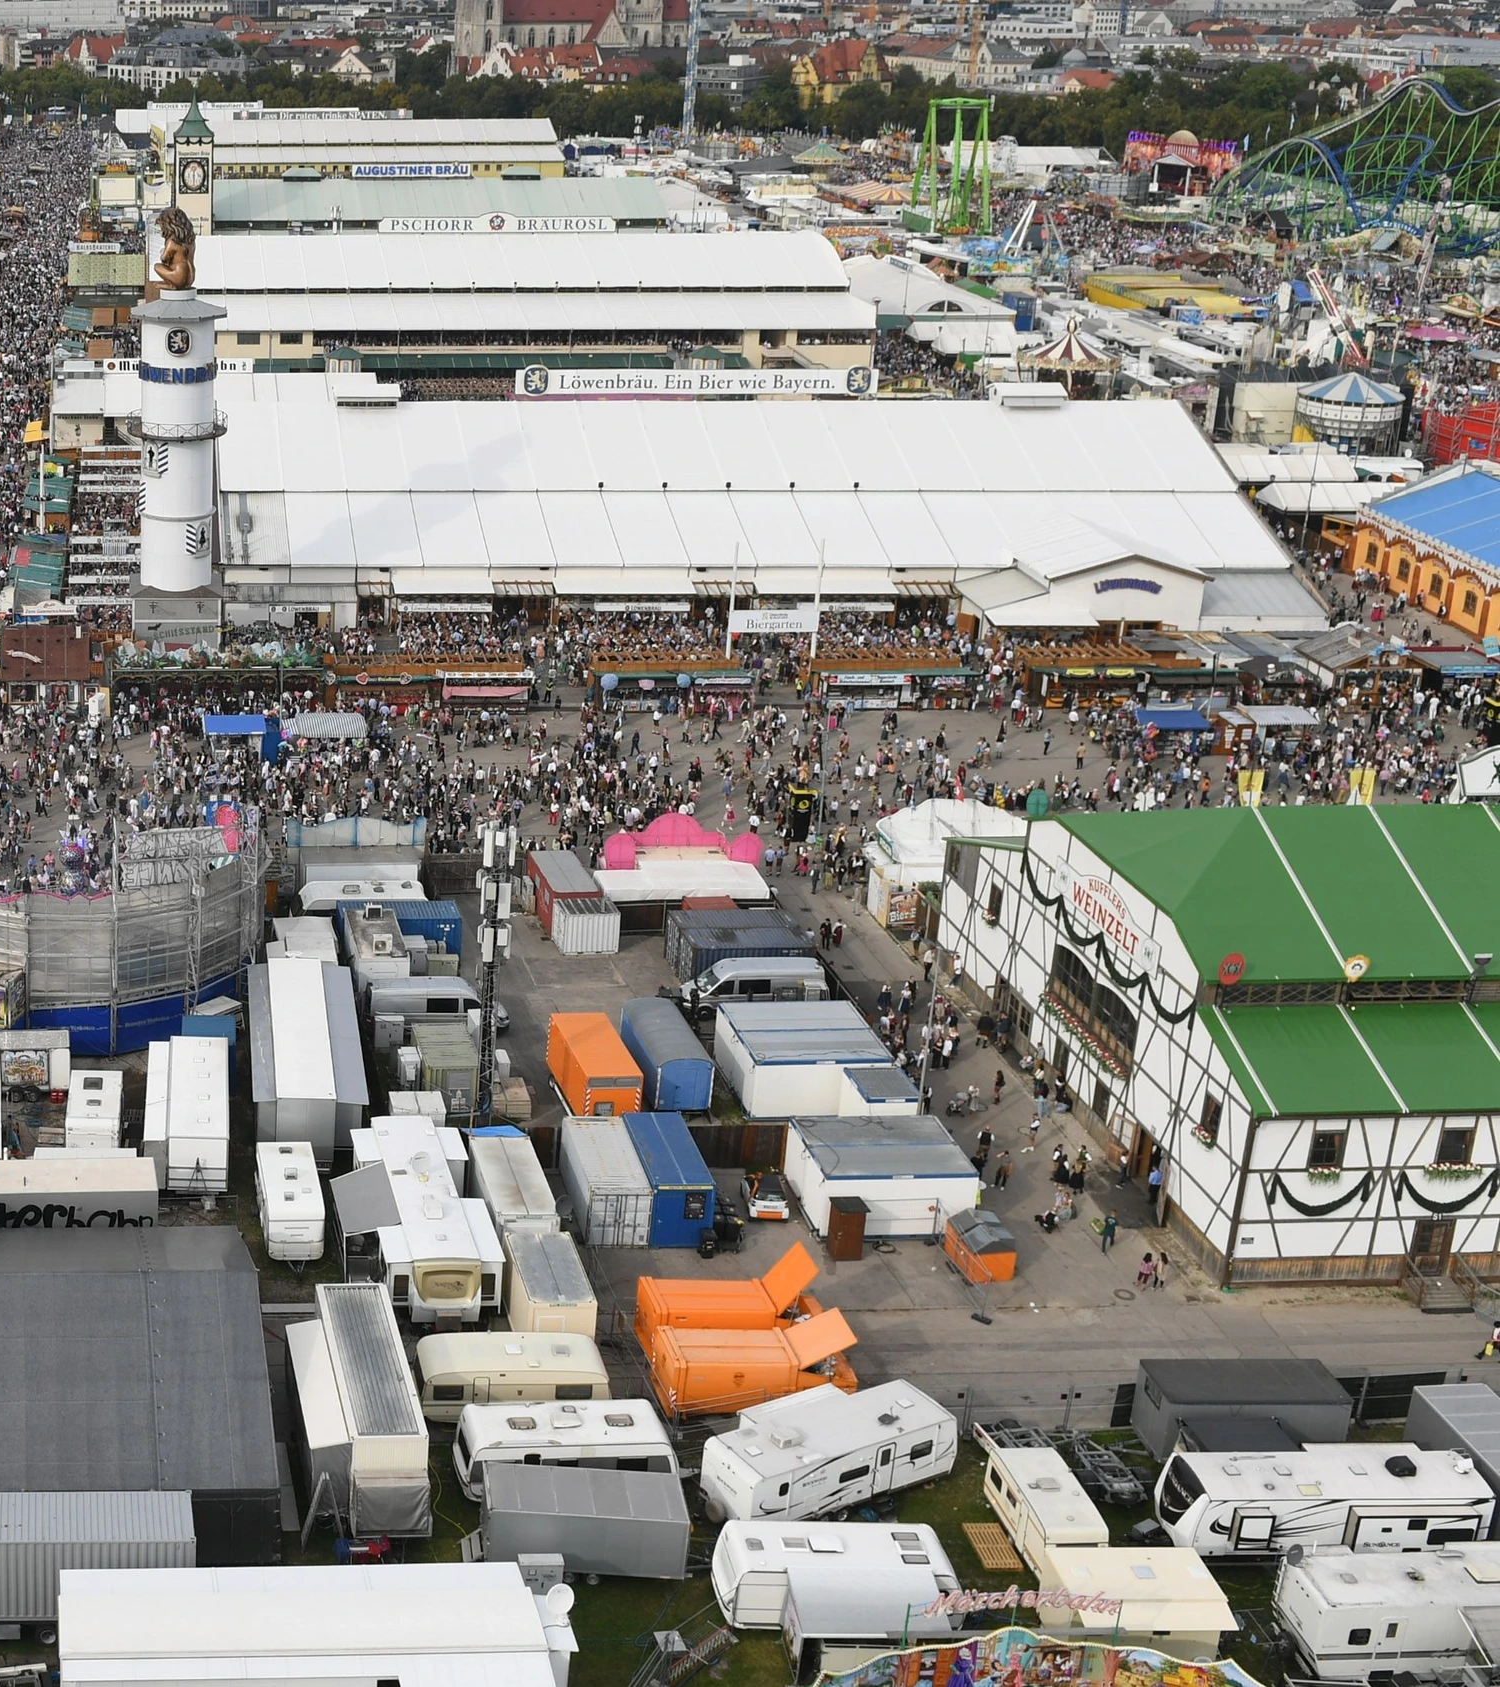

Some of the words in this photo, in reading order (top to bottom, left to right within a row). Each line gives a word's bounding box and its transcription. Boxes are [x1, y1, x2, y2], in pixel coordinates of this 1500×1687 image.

[280, 112, 294, 120] Dir
[321, 111, 348, 120] trinke
[349, 110, 388, 120] SPATEN.
[355, 165, 432, 176] AUGUSTINER
[436, 163, 469, 176] BRÄU
[391, 219, 473, 231] PSCHORR
[517, 218, 607, 231] BRÄUROSL
[559, 373, 658, 389] Löwenbräu.
[664, 374, 692, 389] Ein
[699, 374, 733, 390] Bier
[738, 374, 766, 389] wie
[772, 374, 835, 393] Bayern.
[746, 619, 803, 631] Biergarten
[1088, 878, 1126, 920] KUFFLERS
[1072, 881, 1140, 956] WEINZELT
[1432, 1213, 1442, 1221] S1
[924, 1584, 1122, 1618] Märchenbahn
